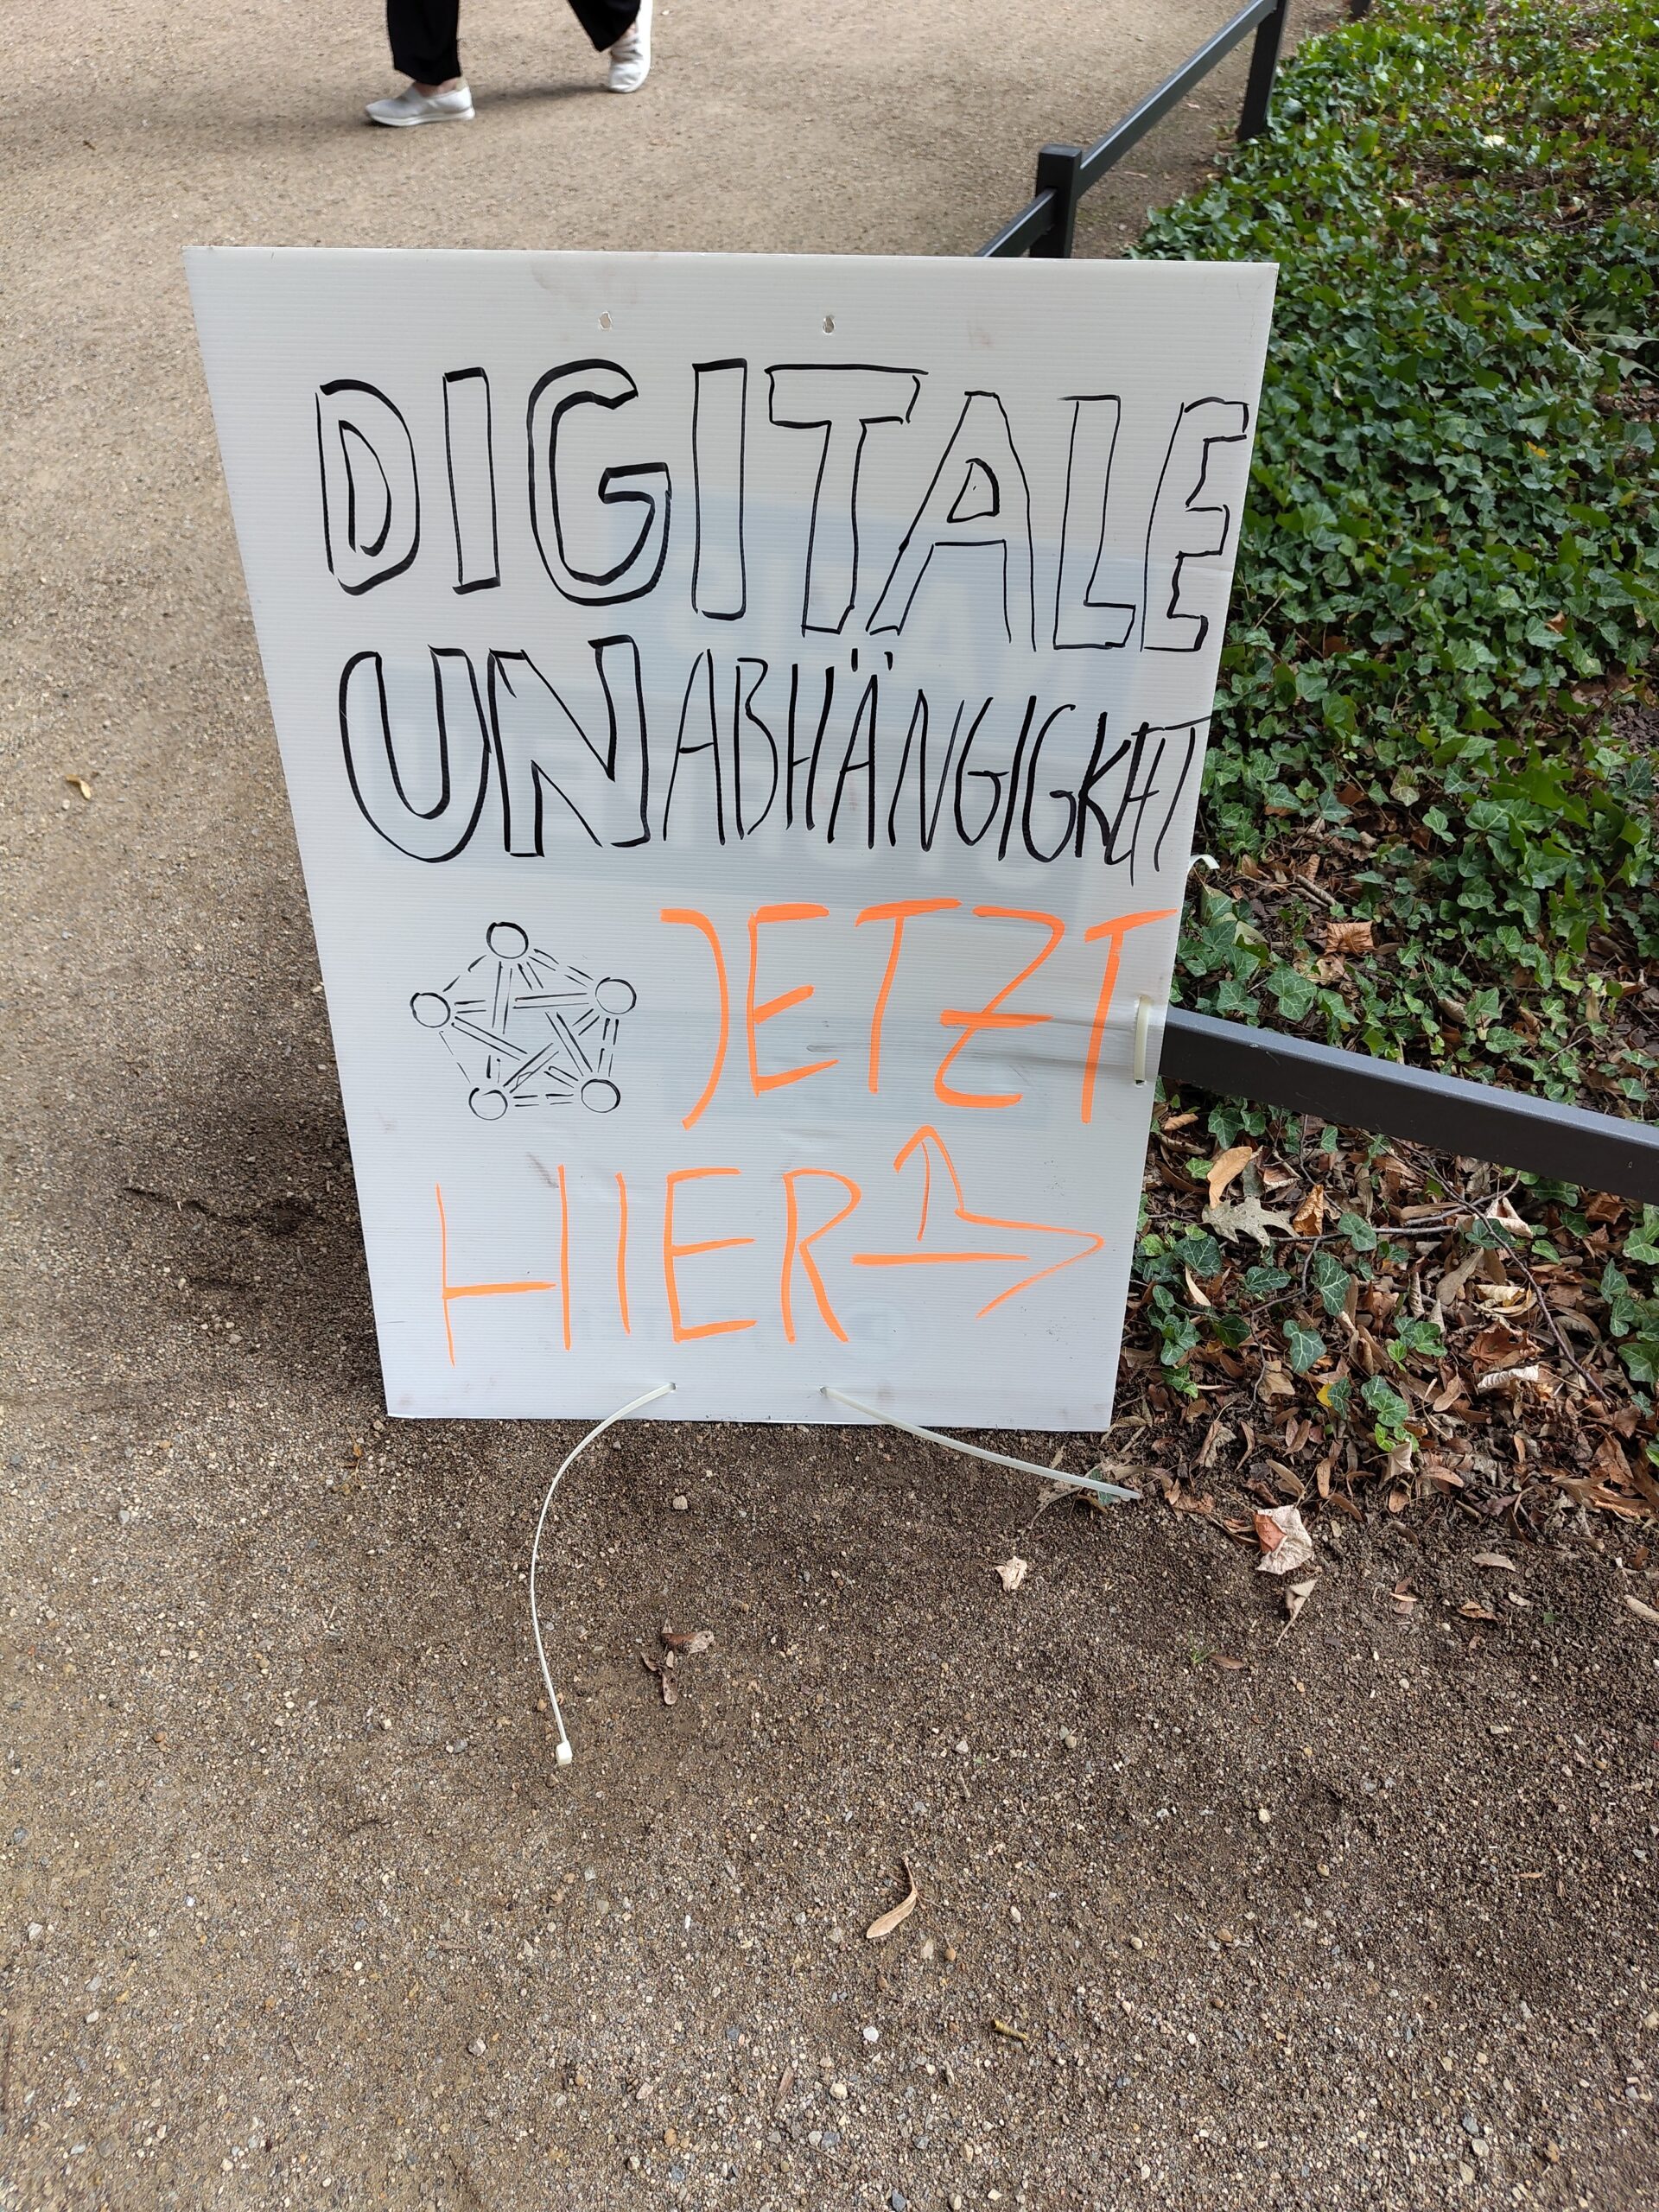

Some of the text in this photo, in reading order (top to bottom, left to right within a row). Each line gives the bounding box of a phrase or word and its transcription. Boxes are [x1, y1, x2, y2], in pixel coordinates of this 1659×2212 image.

[315, 359, 1249, 653] DIGITALE
[339, 634, 1211, 887] UNABHÄNGIGKEIT
[661, 898, 1177, 1131] JETZT
[435, 1163, 861, 1367] HIER
